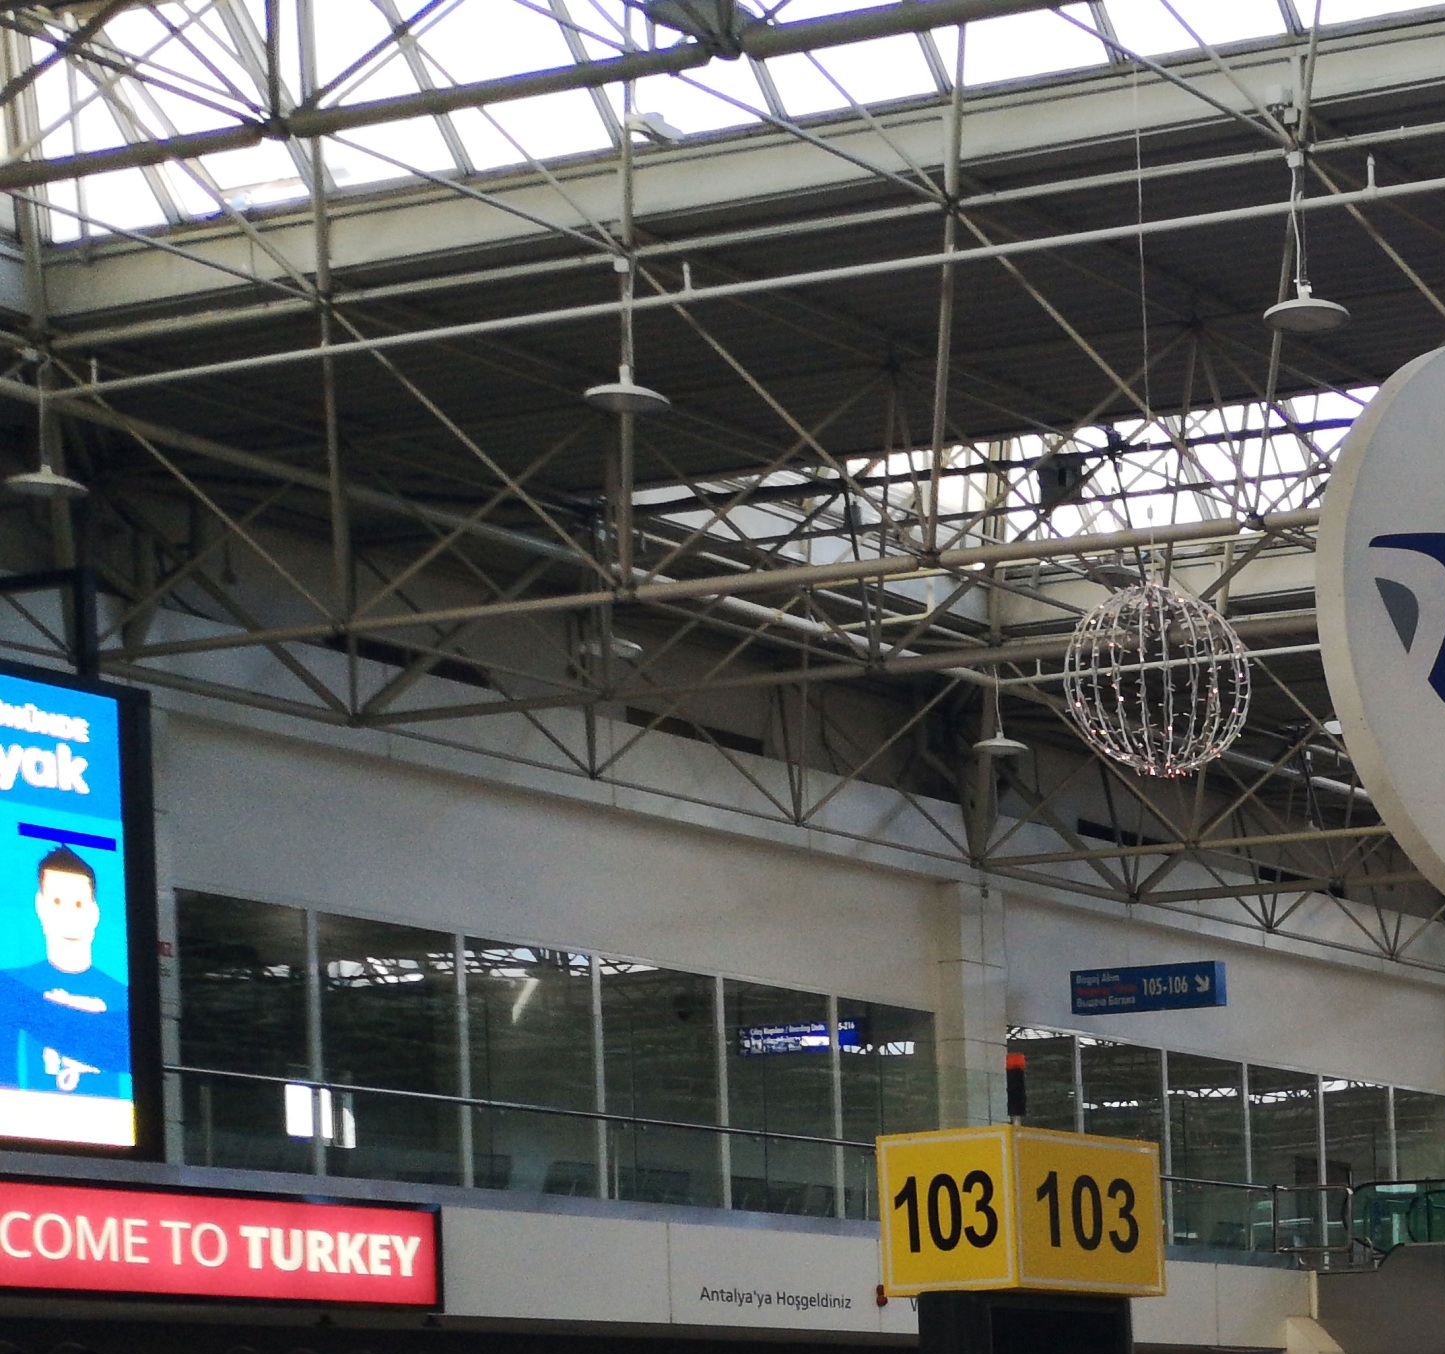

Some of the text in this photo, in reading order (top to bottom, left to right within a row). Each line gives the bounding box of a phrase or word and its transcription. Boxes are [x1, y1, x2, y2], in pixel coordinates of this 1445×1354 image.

[1142, 975, 1188, 996] 105-106
[1, 1211, 421, 1278] COME TO TURKEY
[893, 1169, 999, 1254] 103
[1035, 1170, 1140, 1254] 103
[700, 1287, 852, 1311] Antalya'ya Hoşgeldiniz
